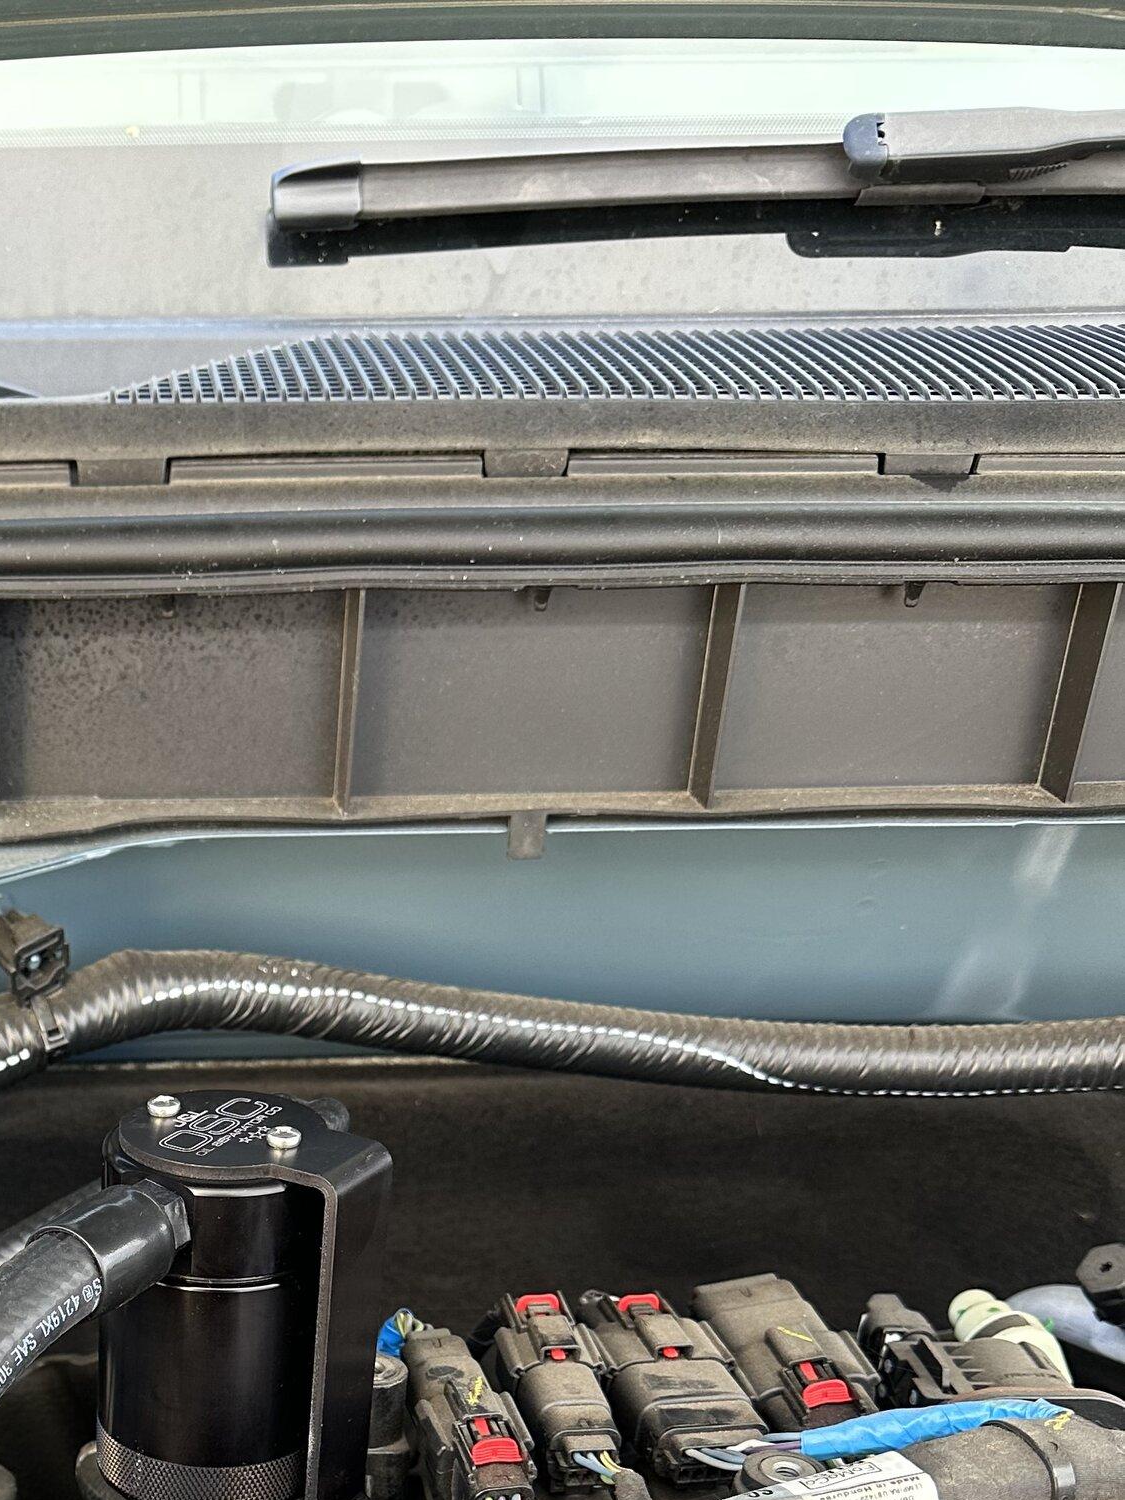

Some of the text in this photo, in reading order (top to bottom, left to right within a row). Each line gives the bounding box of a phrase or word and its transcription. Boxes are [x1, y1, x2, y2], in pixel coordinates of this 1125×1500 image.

[159, 1098, 269, 1152] OSC
[36, 1295, 80, 1337] 4219XL
[10, 1332, 36, 1366] SAE
[890, 1476, 921, 1486] Made
